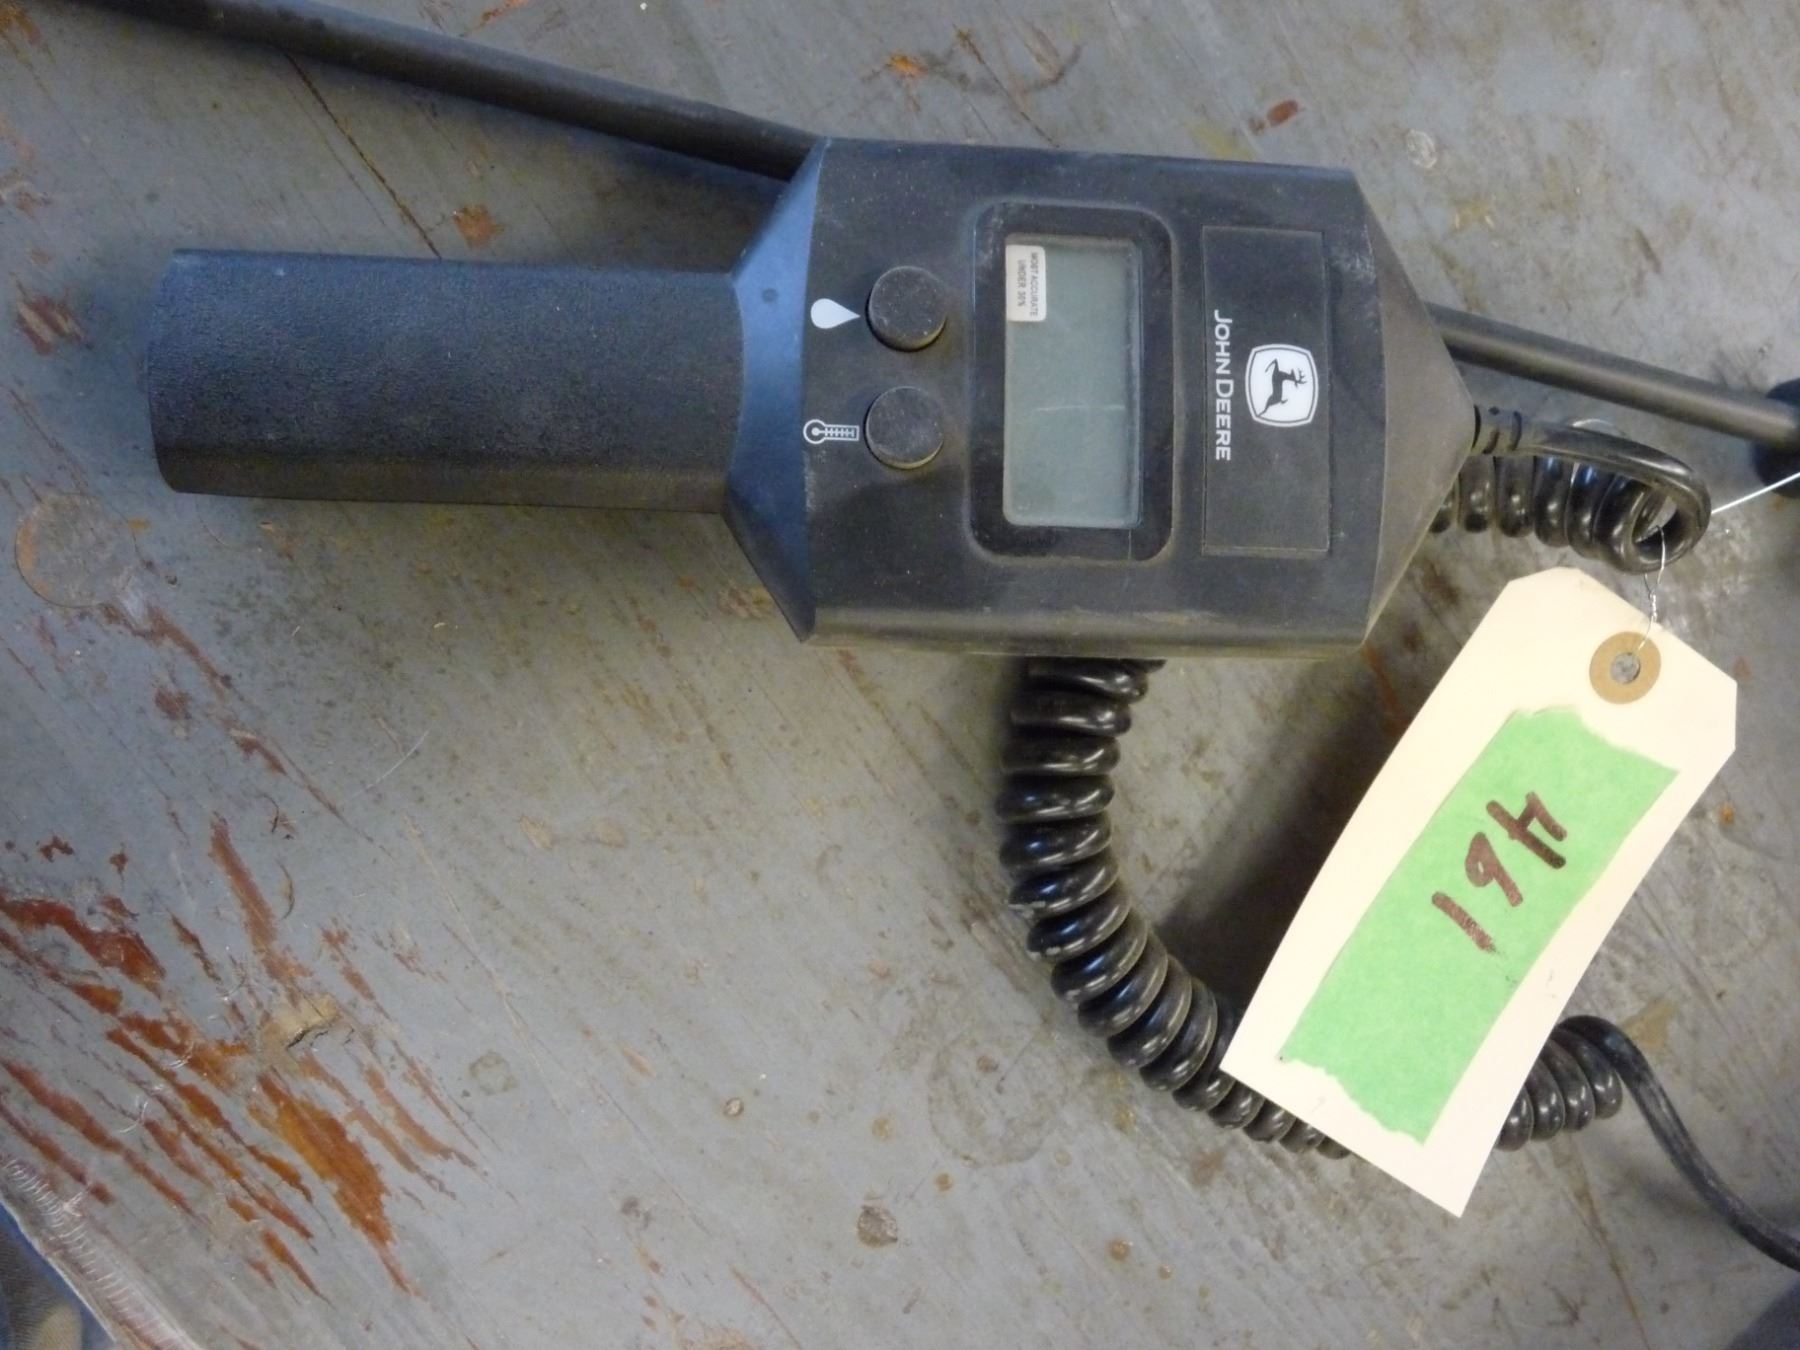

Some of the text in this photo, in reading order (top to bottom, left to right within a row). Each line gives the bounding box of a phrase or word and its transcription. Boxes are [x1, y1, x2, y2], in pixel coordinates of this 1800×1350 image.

[1017, 259, 1027, 288] UNDER
[1029, 252, 1039, 317] MOST ACCURATE
[1214, 309, 1234, 461] JOHN DEERE
[1431, 791, 1568, 953] 461
